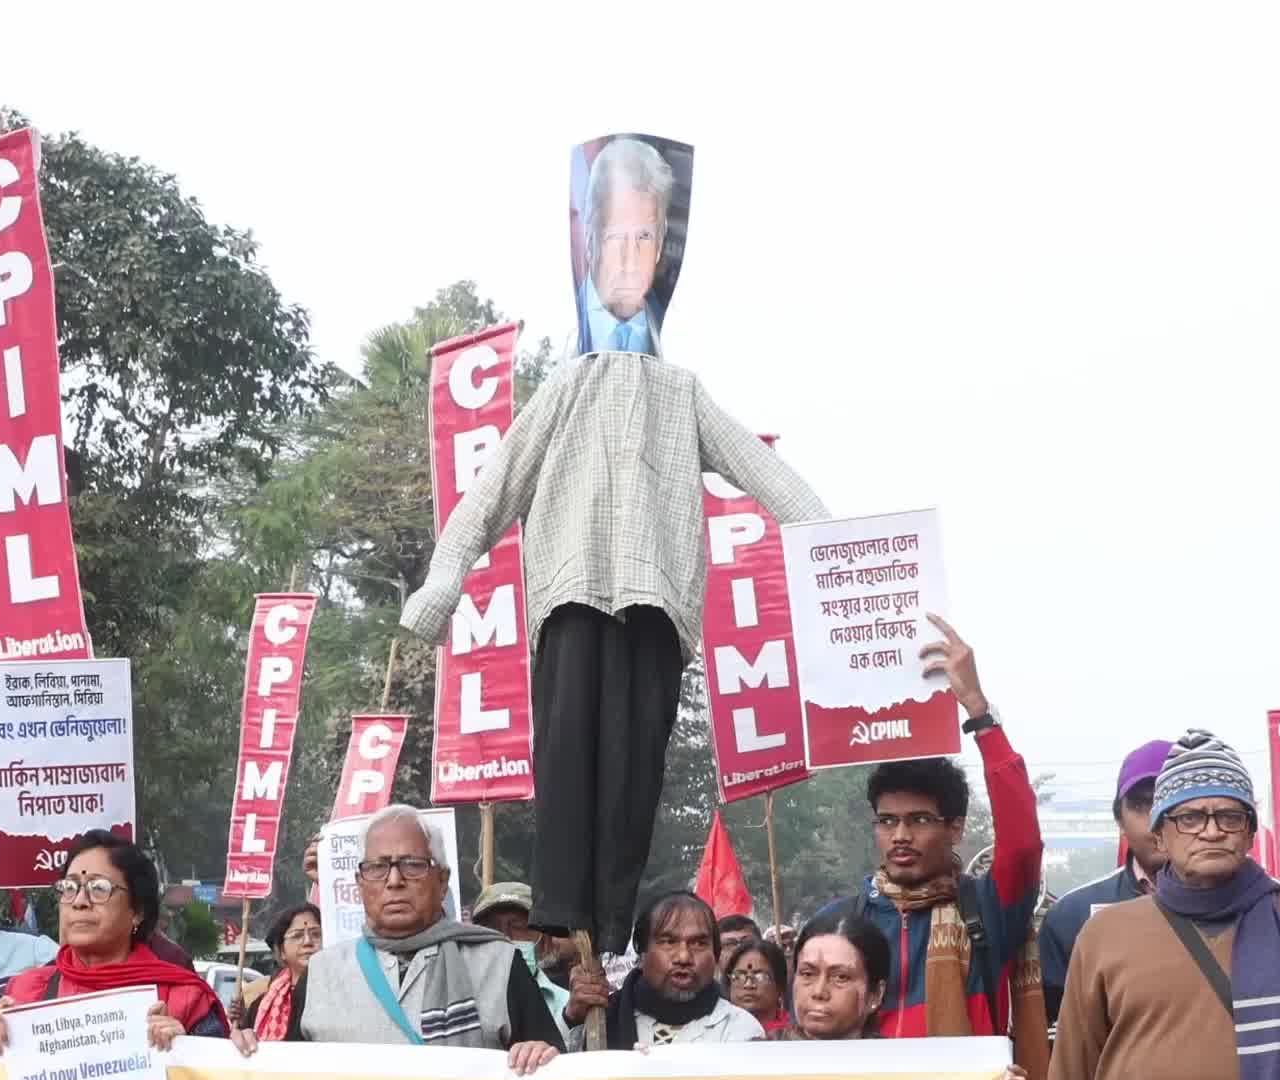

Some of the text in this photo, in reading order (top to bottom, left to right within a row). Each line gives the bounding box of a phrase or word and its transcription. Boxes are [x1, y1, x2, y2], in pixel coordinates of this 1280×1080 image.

[448, 344, 519, 736] CPML
[892, 533, 919, 552] তেল
[815, 559, 919, 590] মার্কিন বহুজাতিক
[862, 594, 890, 614] হাতে
[892, 590, 919, 616] তুলে
[875, 617, 917, 640] বিরুদ্ধে
[849, 653, 869, 670] এক
[17, 720, 47, 739] এখন
[869, 718, 912, 741] CPIML
[41, 762, 128, 786] সাম্রাজ্যবাদ
[437, 758, 531, 783] Liberation
[723, 758, 806, 788] Liberation
[17, 790, 105, 817] নিপাত যাক!
[84, 1009, 128, 1027] Panama,
[39, 1028, 126, 1056] Afghanistan, Syria
[79, 1053, 152, 1080] Venezuela!
